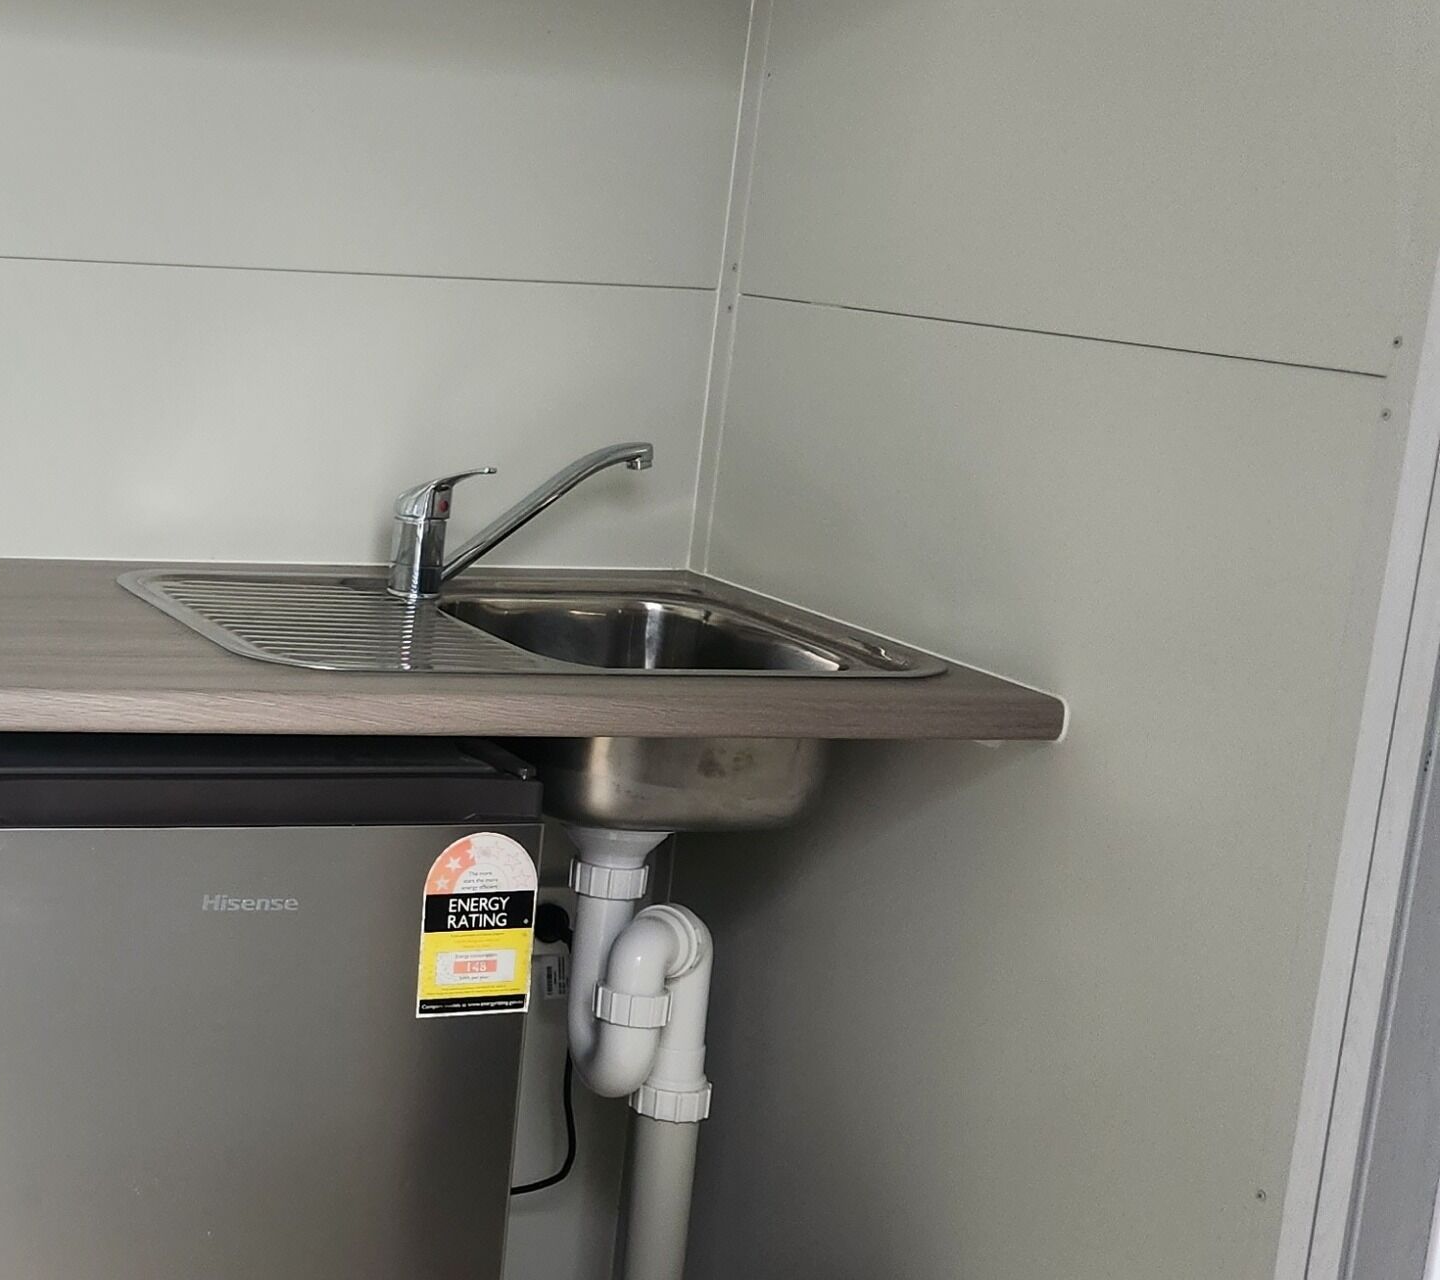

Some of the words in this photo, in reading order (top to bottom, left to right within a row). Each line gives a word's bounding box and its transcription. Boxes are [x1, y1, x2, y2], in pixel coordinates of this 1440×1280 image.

[202, 894, 299, 911] Hisense
[448, 896, 510, 913] ENERGY
[447, 912, 508, 929] RATING
